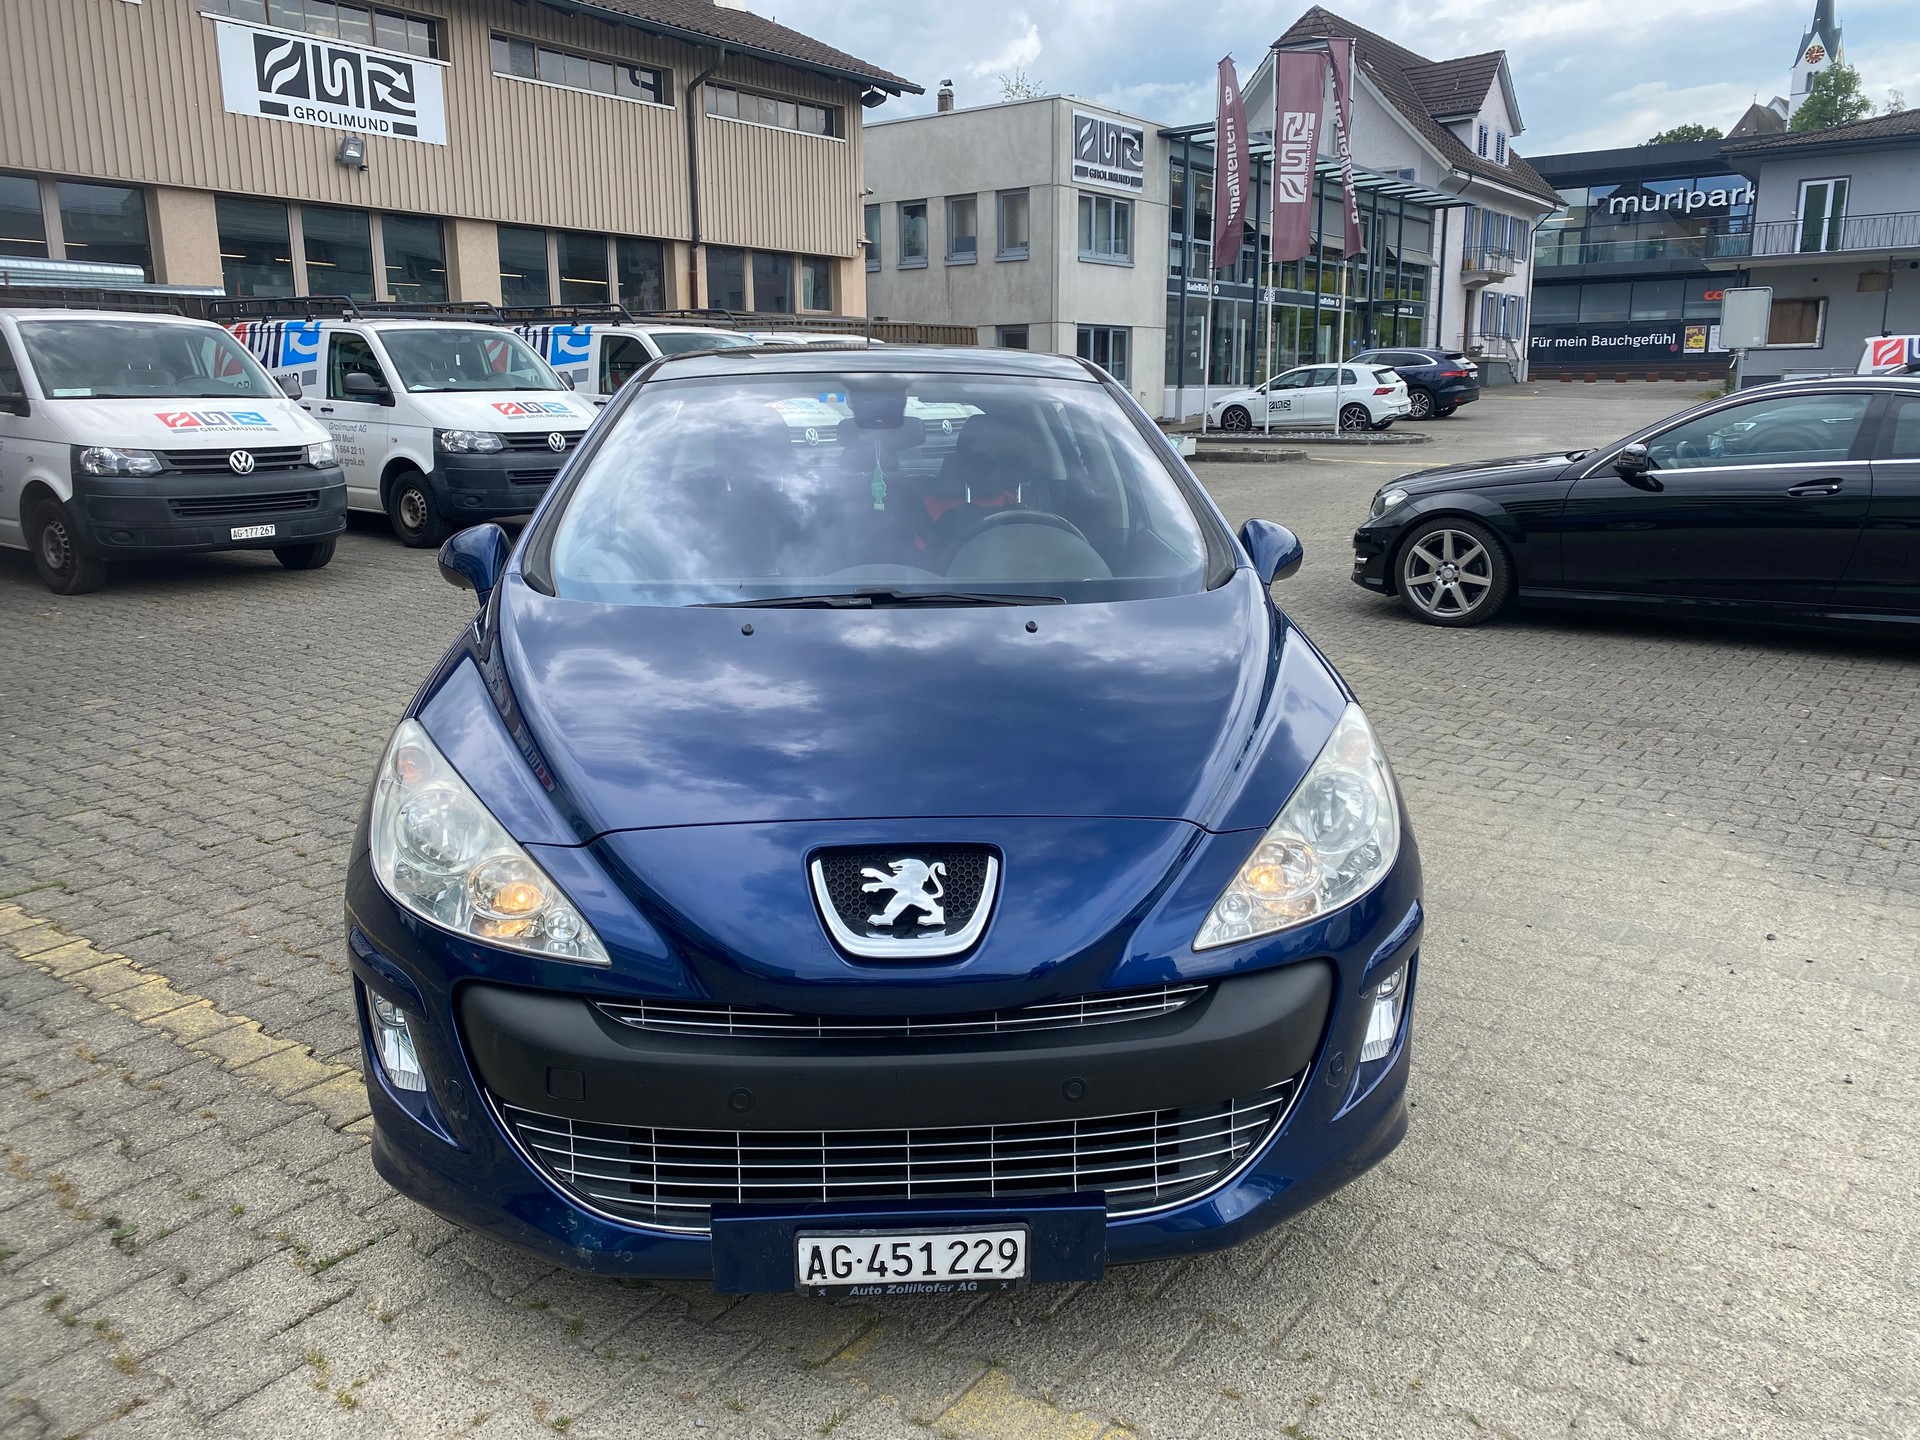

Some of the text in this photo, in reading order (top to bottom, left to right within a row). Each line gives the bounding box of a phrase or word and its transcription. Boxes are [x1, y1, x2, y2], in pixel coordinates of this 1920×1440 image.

[293, 106, 389, 132] GROLIMUND
[1089, 168, 1131, 185] GROLIMUND
[1609, 182, 1755, 214] muripark
[1704, 290, 1724, 300] co
[1531, 333, 1676, 348] Für mein Bauchgefühl
[358, 424, 367, 433] AG
[331, 433, 355, 443] 630 Muri
[350, 446, 357, 455] 22
[358, 447, 365, 455] 11
[849, 1281, 978, 1296] Auto Zollikofer AG
